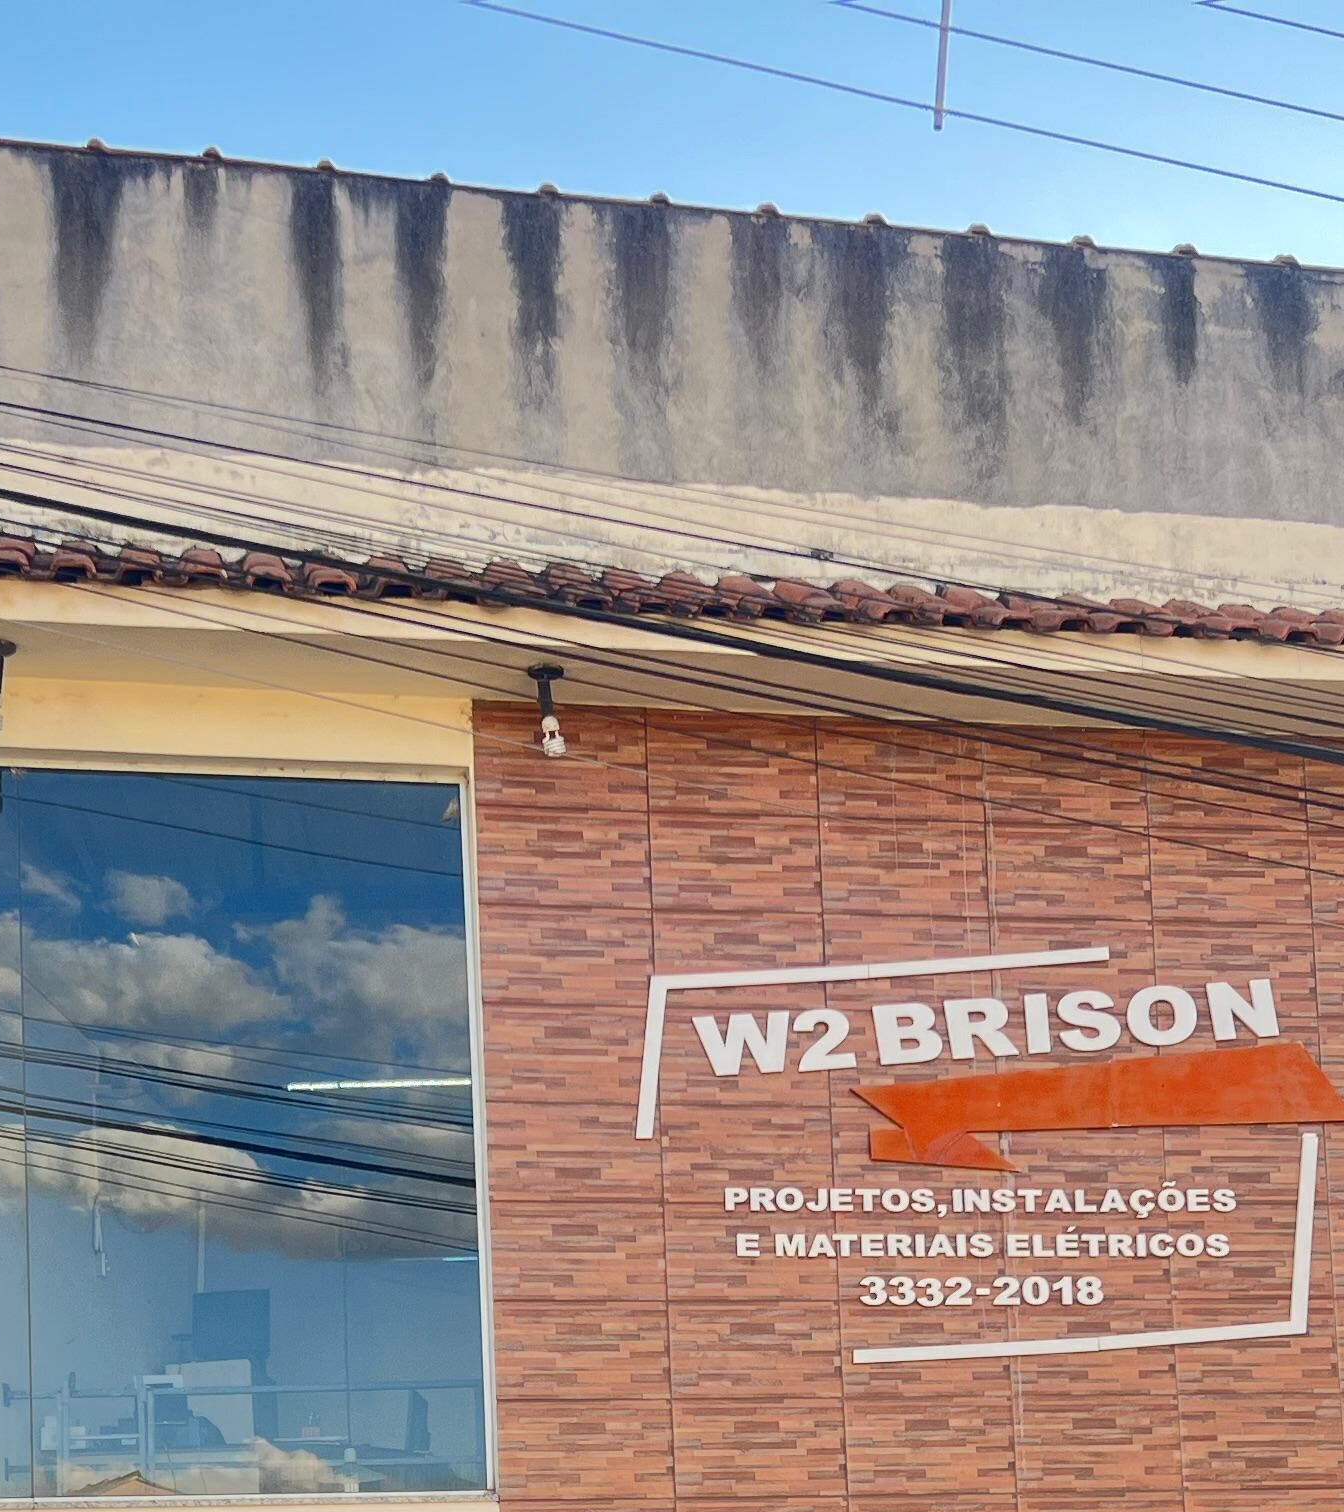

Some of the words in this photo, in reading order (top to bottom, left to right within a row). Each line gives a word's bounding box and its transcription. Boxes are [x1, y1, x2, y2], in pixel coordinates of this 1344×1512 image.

[691, 1008, 857, 1077] W2
[870, 977, 1280, 1066] BRISON
[736, 1233, 761, 1257] E
[775, 1233, 994, 1257] MATERIAIS
[1006, 1225, 1230, 1257] ELÉTRICOS
[859, 1276, 1104, 1307] 3332-2018
